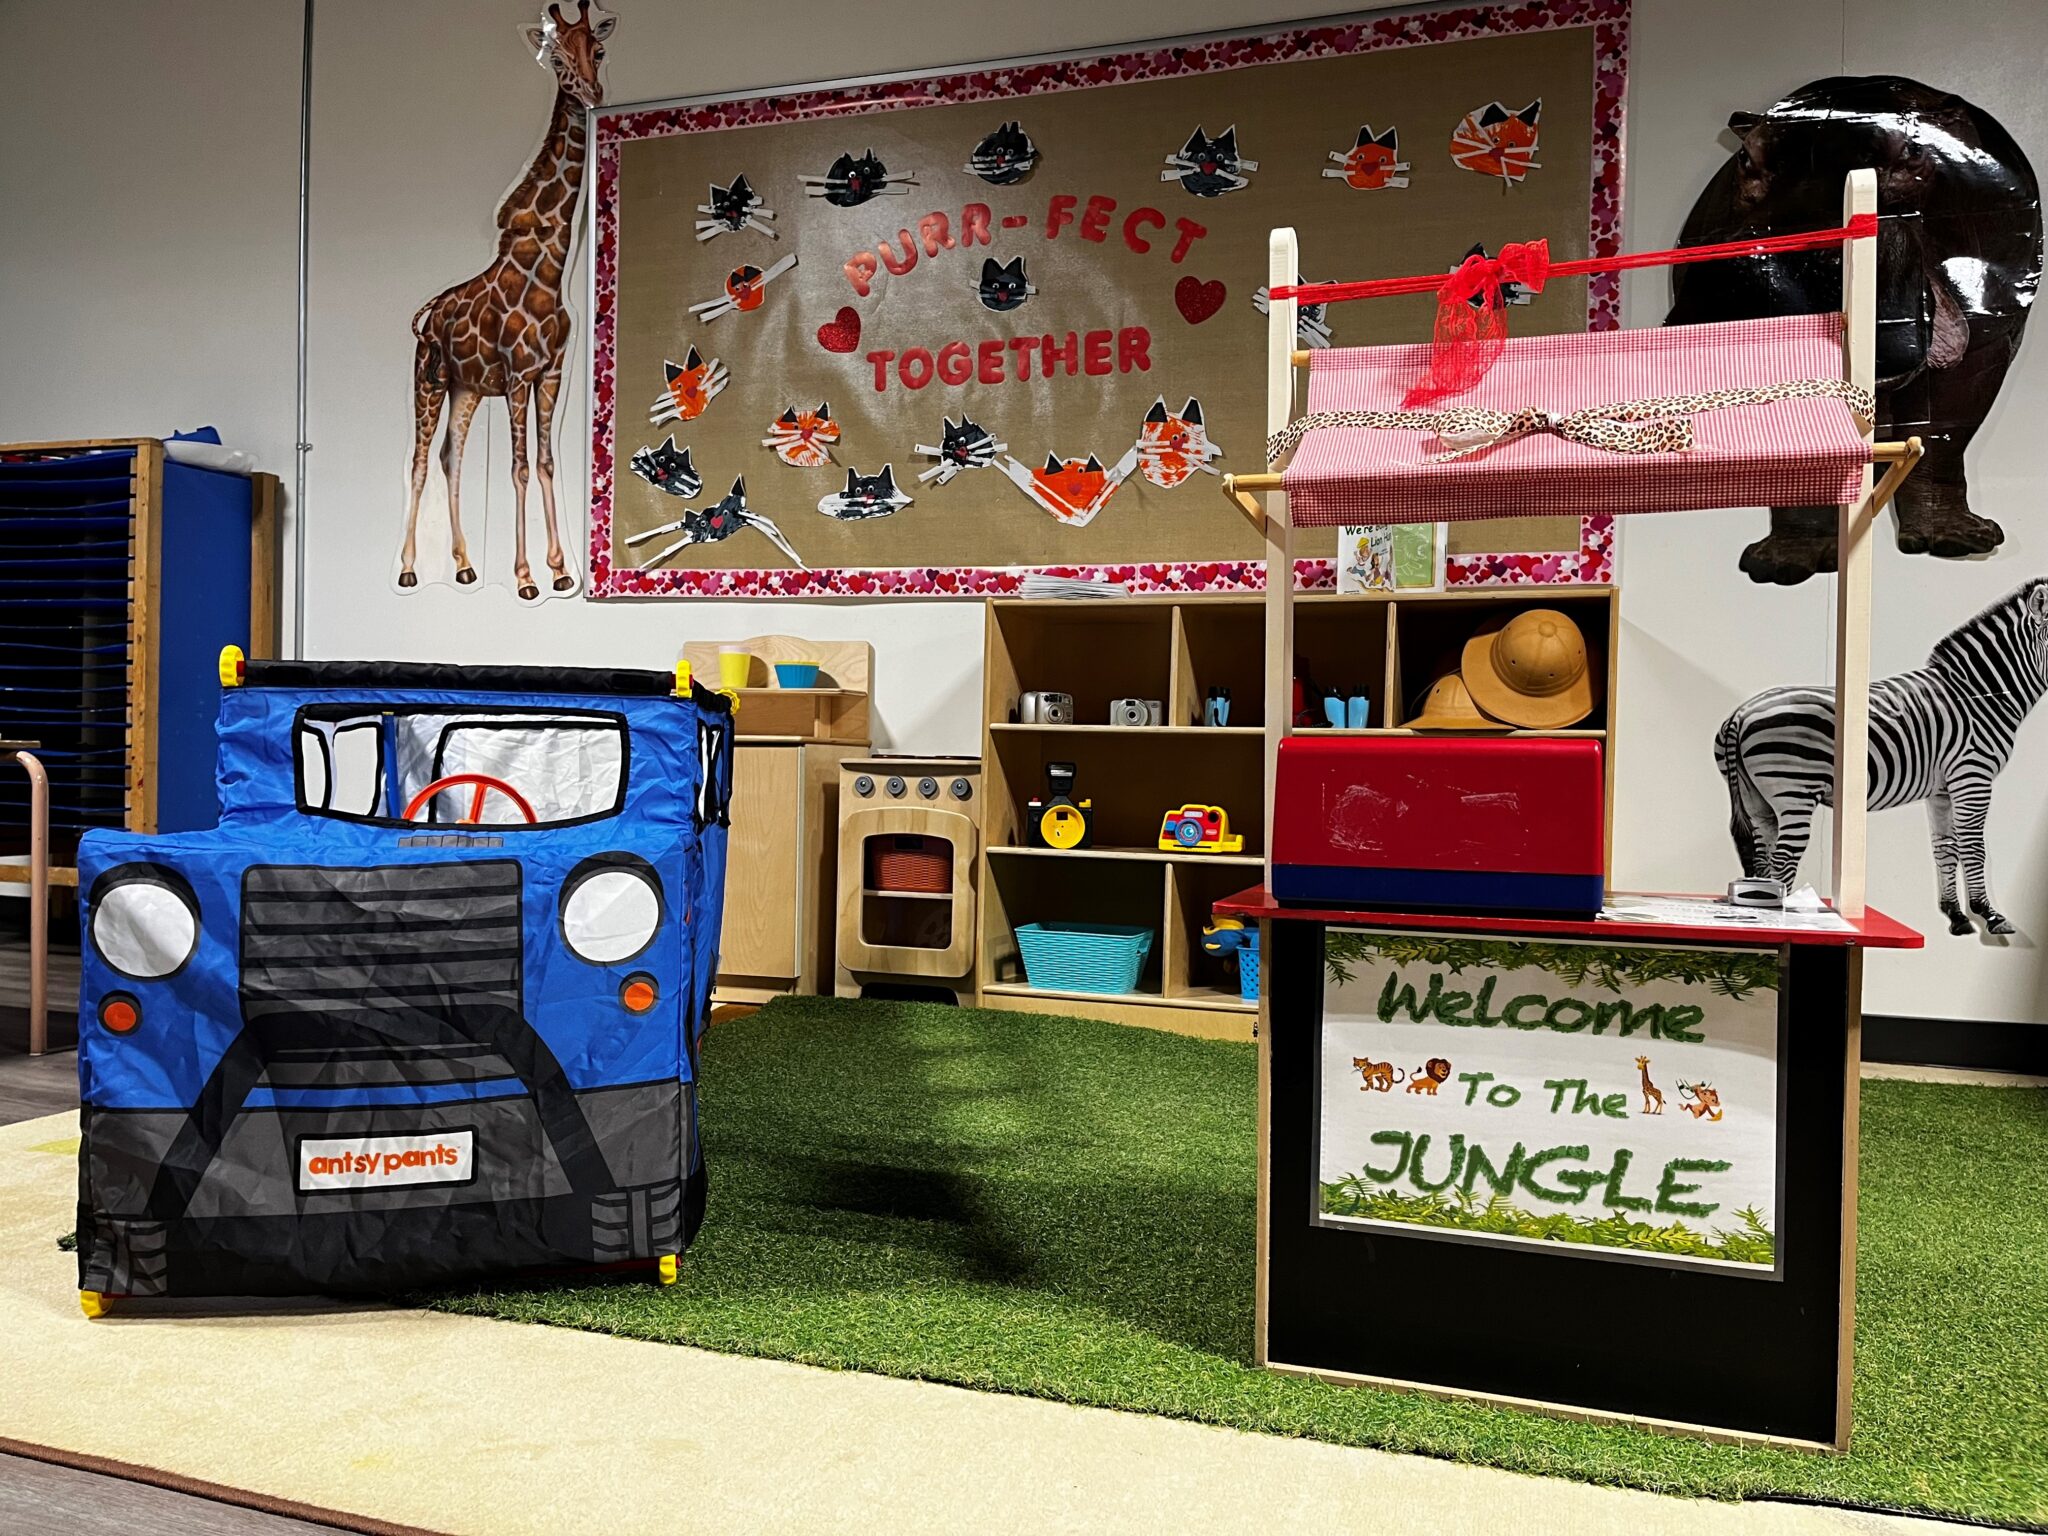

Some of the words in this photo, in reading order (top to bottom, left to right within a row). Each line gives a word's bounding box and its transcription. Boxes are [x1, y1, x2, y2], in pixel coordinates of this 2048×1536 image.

[843, 195, 1207, 297] PURR-FECT
[866, 326, 1152, 392] TOGETHER
[1371, 536, 1382, 547] Lion
[1376, 971, 1705, 1043] Welcome
[1458, 1071, 1521, 1108] To
[1543, 1078, 1629, 1119] The
[1363, 1130, 1733, 1217] JUNGLE
